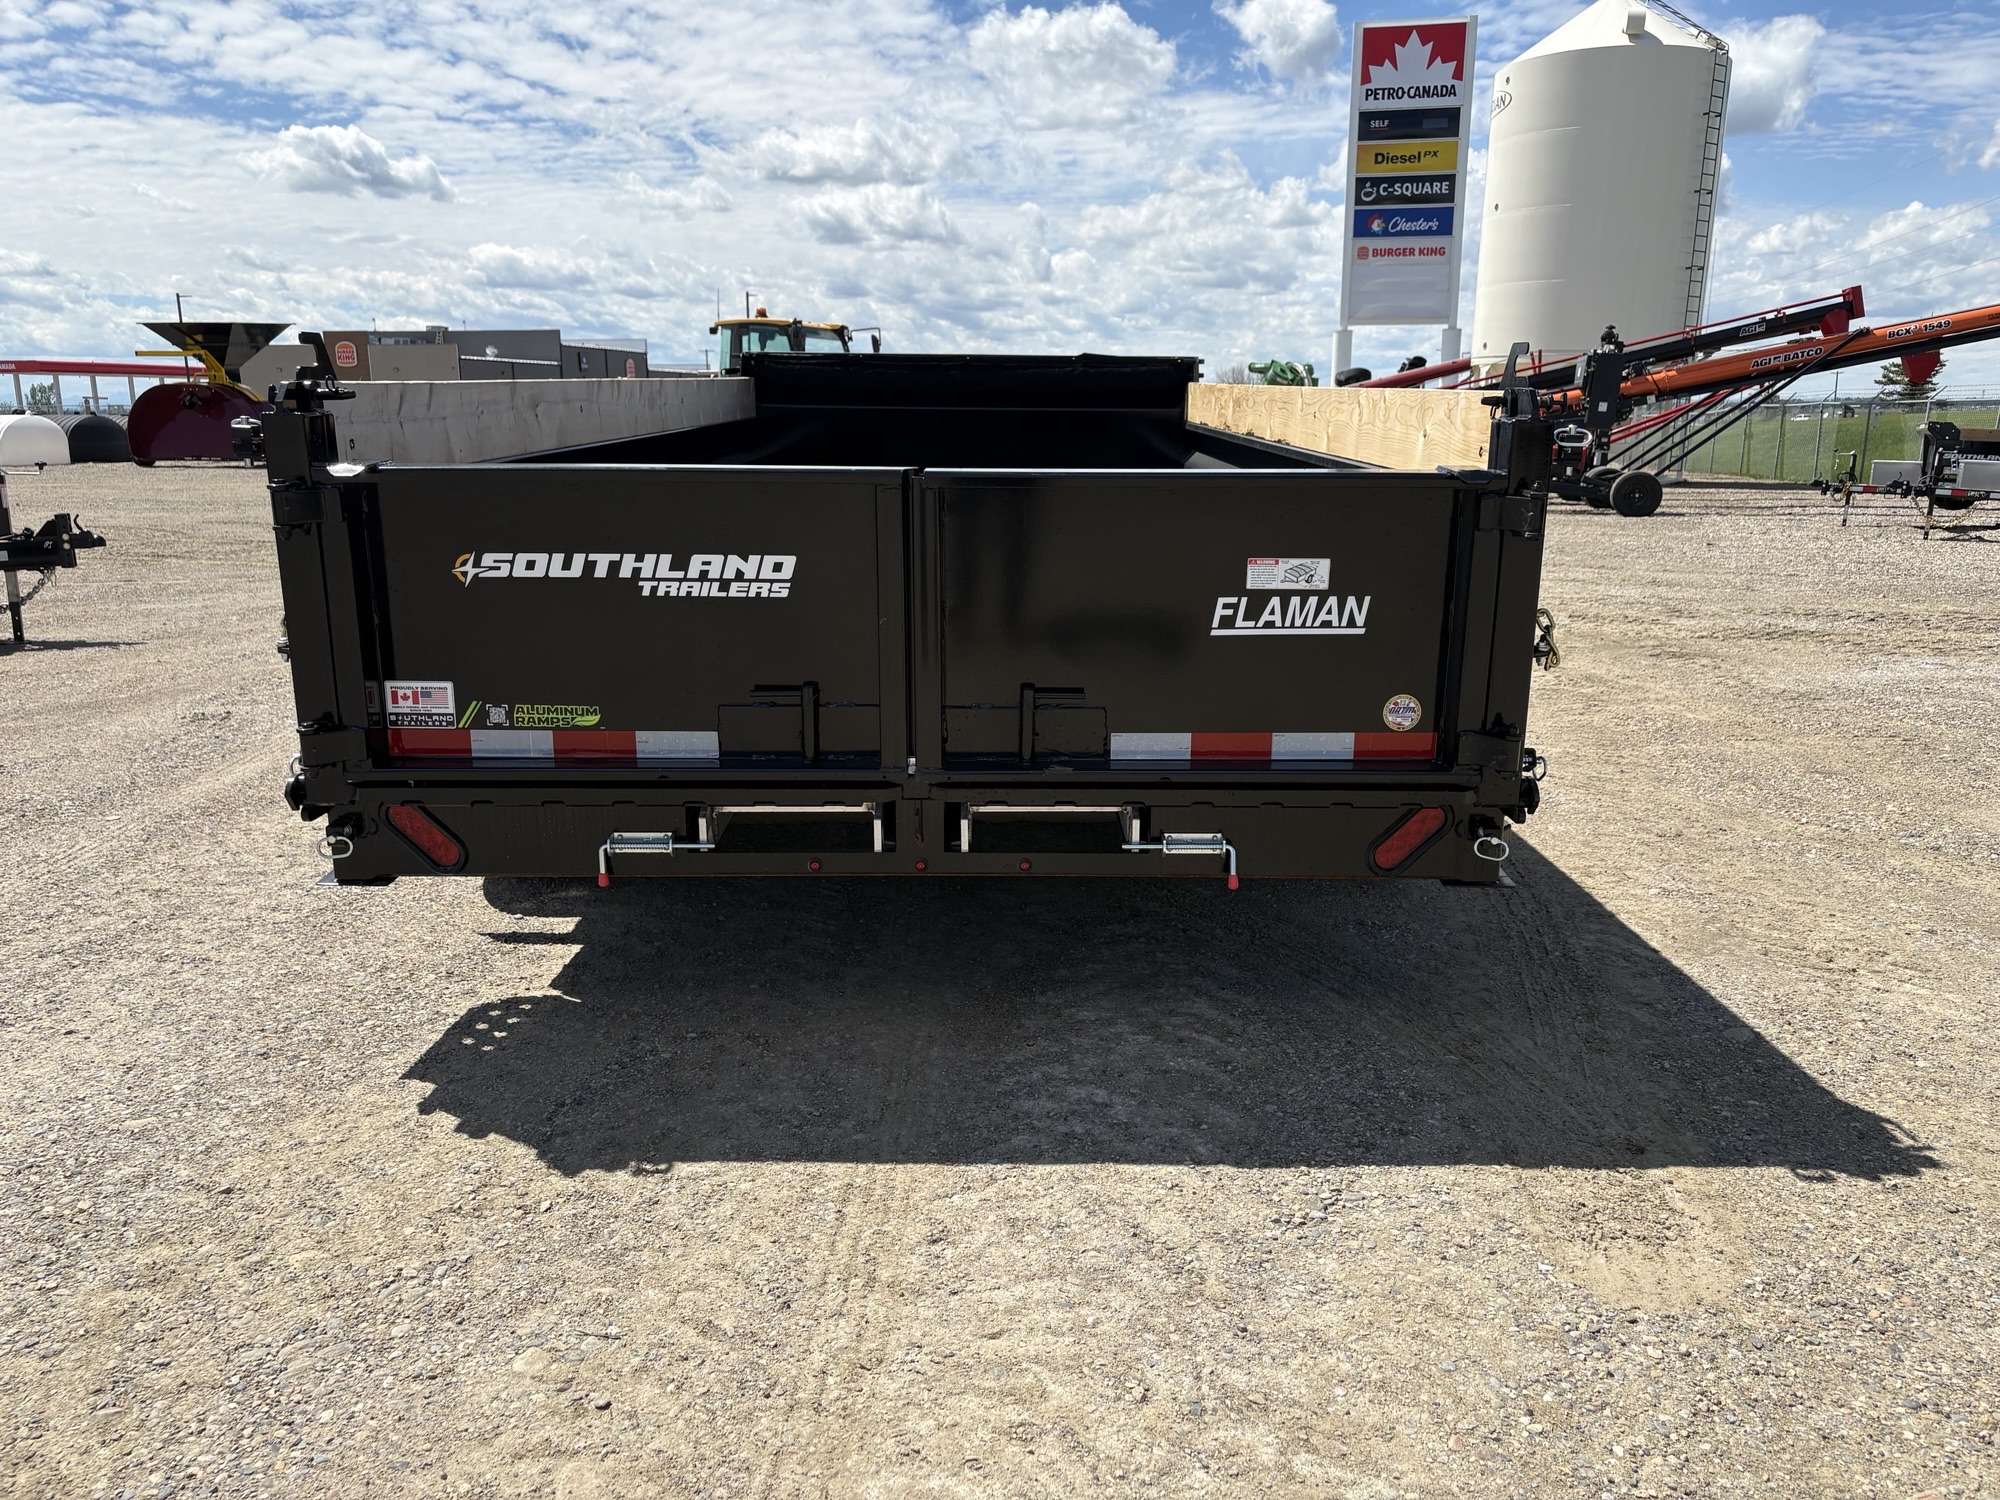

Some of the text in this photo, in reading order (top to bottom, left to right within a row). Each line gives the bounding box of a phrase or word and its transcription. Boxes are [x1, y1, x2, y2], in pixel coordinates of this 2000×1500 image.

[1369, 119, 1390, 128] SELF
[1374, 150, 1440, 165] Diesel PX
[1380, 181, 1450, 197] C-SQUARE
[1388, 216, 1439, 232] Chester's
[1372, 246, 1446, 258] BURGER KING
[1922, 319, 1952, 332] 1549
[337, 353, 355, 361] KING
[1751, 347, 1824, 369] AGI BATCO
[478, 552, 797, 579] SOUTHLAND
[638, 581, 792, 598] TRAILERS
[1211, 595, 1371, 629] FLAMAN
[514, 704, 600, 717] ALUMINUM
[514, 716, 572, 728] RAMPS
